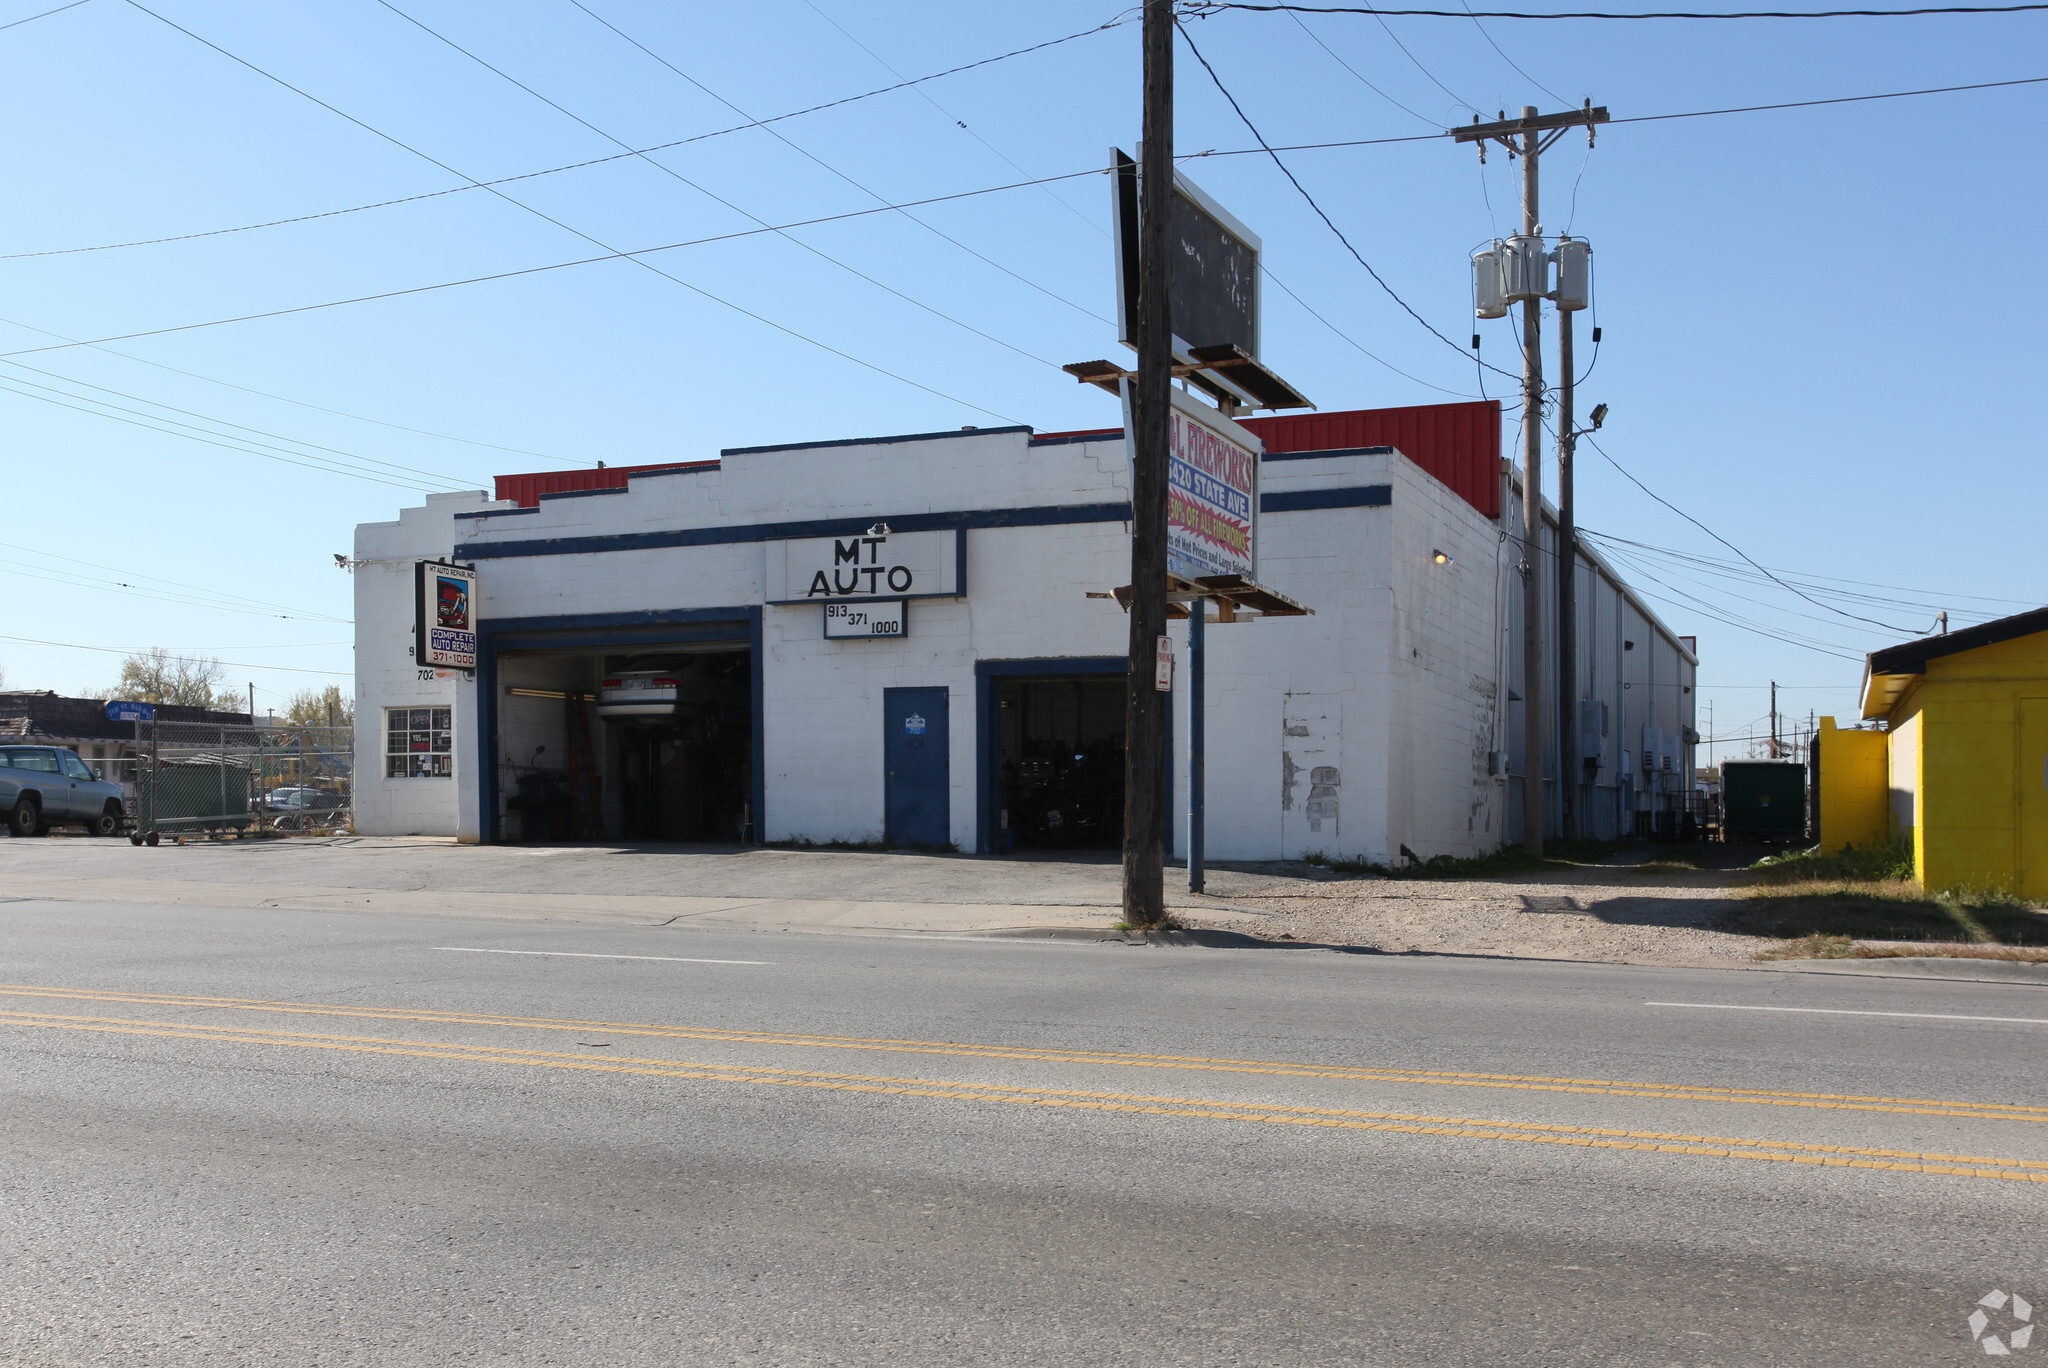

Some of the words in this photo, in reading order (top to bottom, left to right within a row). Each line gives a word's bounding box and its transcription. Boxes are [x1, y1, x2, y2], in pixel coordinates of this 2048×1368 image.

[1187, 420, 1252, 496] FIREWORKS
[1194, 472, 1226, 508] STATE
[1228, 490, 1248, 519] AVE.
[1170, 496, 1186, 525] 50%
[1187, 504, 1200, 530] OFF
[1200, 511, 1213, 536] ALL
[1213, 517, 1247, 553] FIREWORKS
[835, 536, 886, 567] MT
[1174, 535, 1181, 549] of
[1182, 537, 1192, 555] Hot
[1192, 542, 1208, 560] Prices
[1209, 552, 1218, 565] and
[1218, 553, 1231, 573] Large
[1232, 560, 1252, 580] Selection
[437, 566, 450, 576] AUTO
[807, 565, 913, 598] AUTO
[828, 605, 847, 617] 913
[848, 613, 868, 625] 371
[871, 620, 899, 634] 1000
[432, 629, 475, 643] COMPLETE
[432, 638, 451, 651] AUTO
[451, 641, 475, 653] REPAIR
[417, 669, 434, 681] 702
